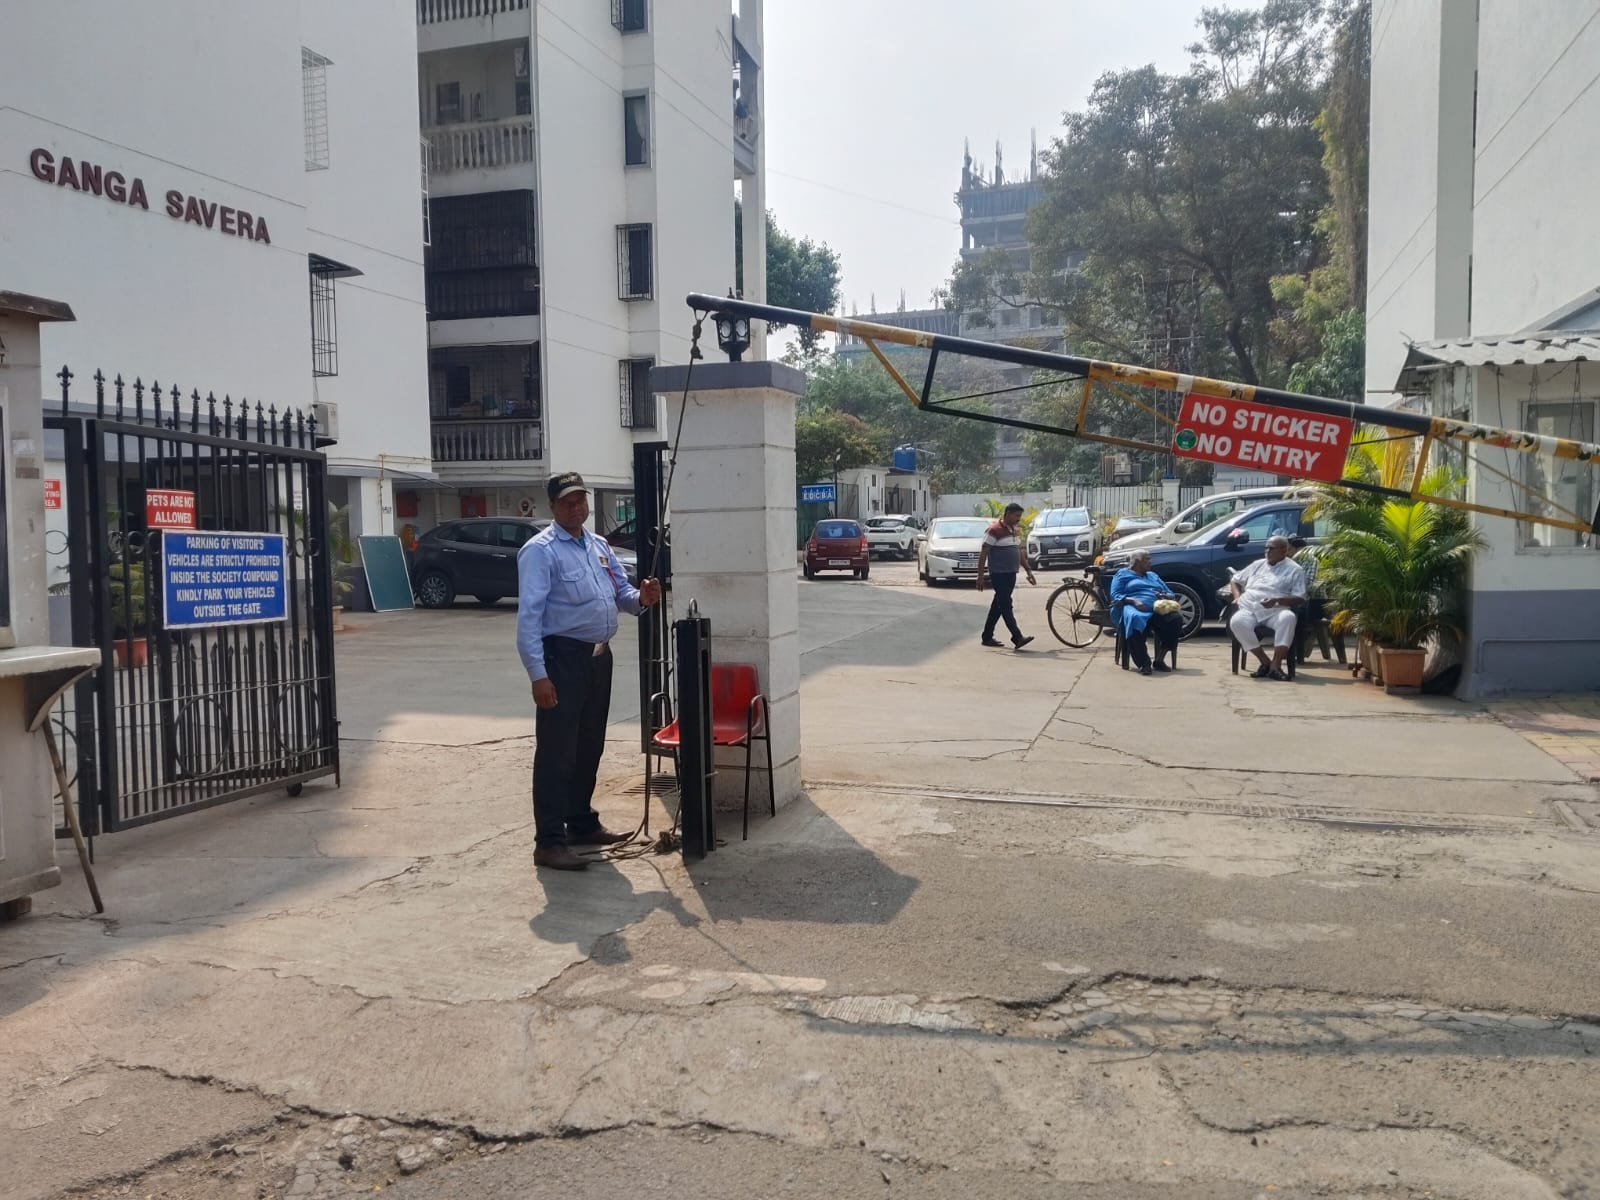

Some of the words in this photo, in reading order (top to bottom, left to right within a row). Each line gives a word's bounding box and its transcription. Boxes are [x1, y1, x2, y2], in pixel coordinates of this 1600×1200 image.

[30, 147, 149, 211] GANGA
[165, 190, 271, 244] SAVERA
[1191, 402, 1227, 426] NO
[1232, 408, 1340, 446] STICKER
[1197, 433, 1232, 456] NO
[1237, 439, 1320, 471] ENTRY
[147, 494, 168, 507] PETS
[170, 495, 184, 507] ARE
[184, 496, 194, 508] NOT
[155, 511, 192, 524] ALLOWED
[186, 536, 220, 549] PARKING
[221, 538, 231, 549] OF
[231, 538, 265, 550] VISITOR'S
[168, 554, 200, 566] VEHICLES
[201, 554, 214, 566] ARE
[215, 554, 245, 566] STRICTLY
[245, 555, 280, 566] PROHIBITED
[170, 571, 195, 584] INSIDE
[196, 571, 211, 583] THE
[212, 571, 242, 583] SOCIETY
[242, 570, 279, 582] COMPOUND
[176, 589, 201, 602] KINDLY
[203, 588, 222, 600] PARK
[223, 587, 242, 599] YOUR
[243, 587, 275, 598] VEHICLES
[193, 605, 225, 618] OUTSIDE
[227, 604, 242, 615] THE
[243, 603, 261, 614] GATE
